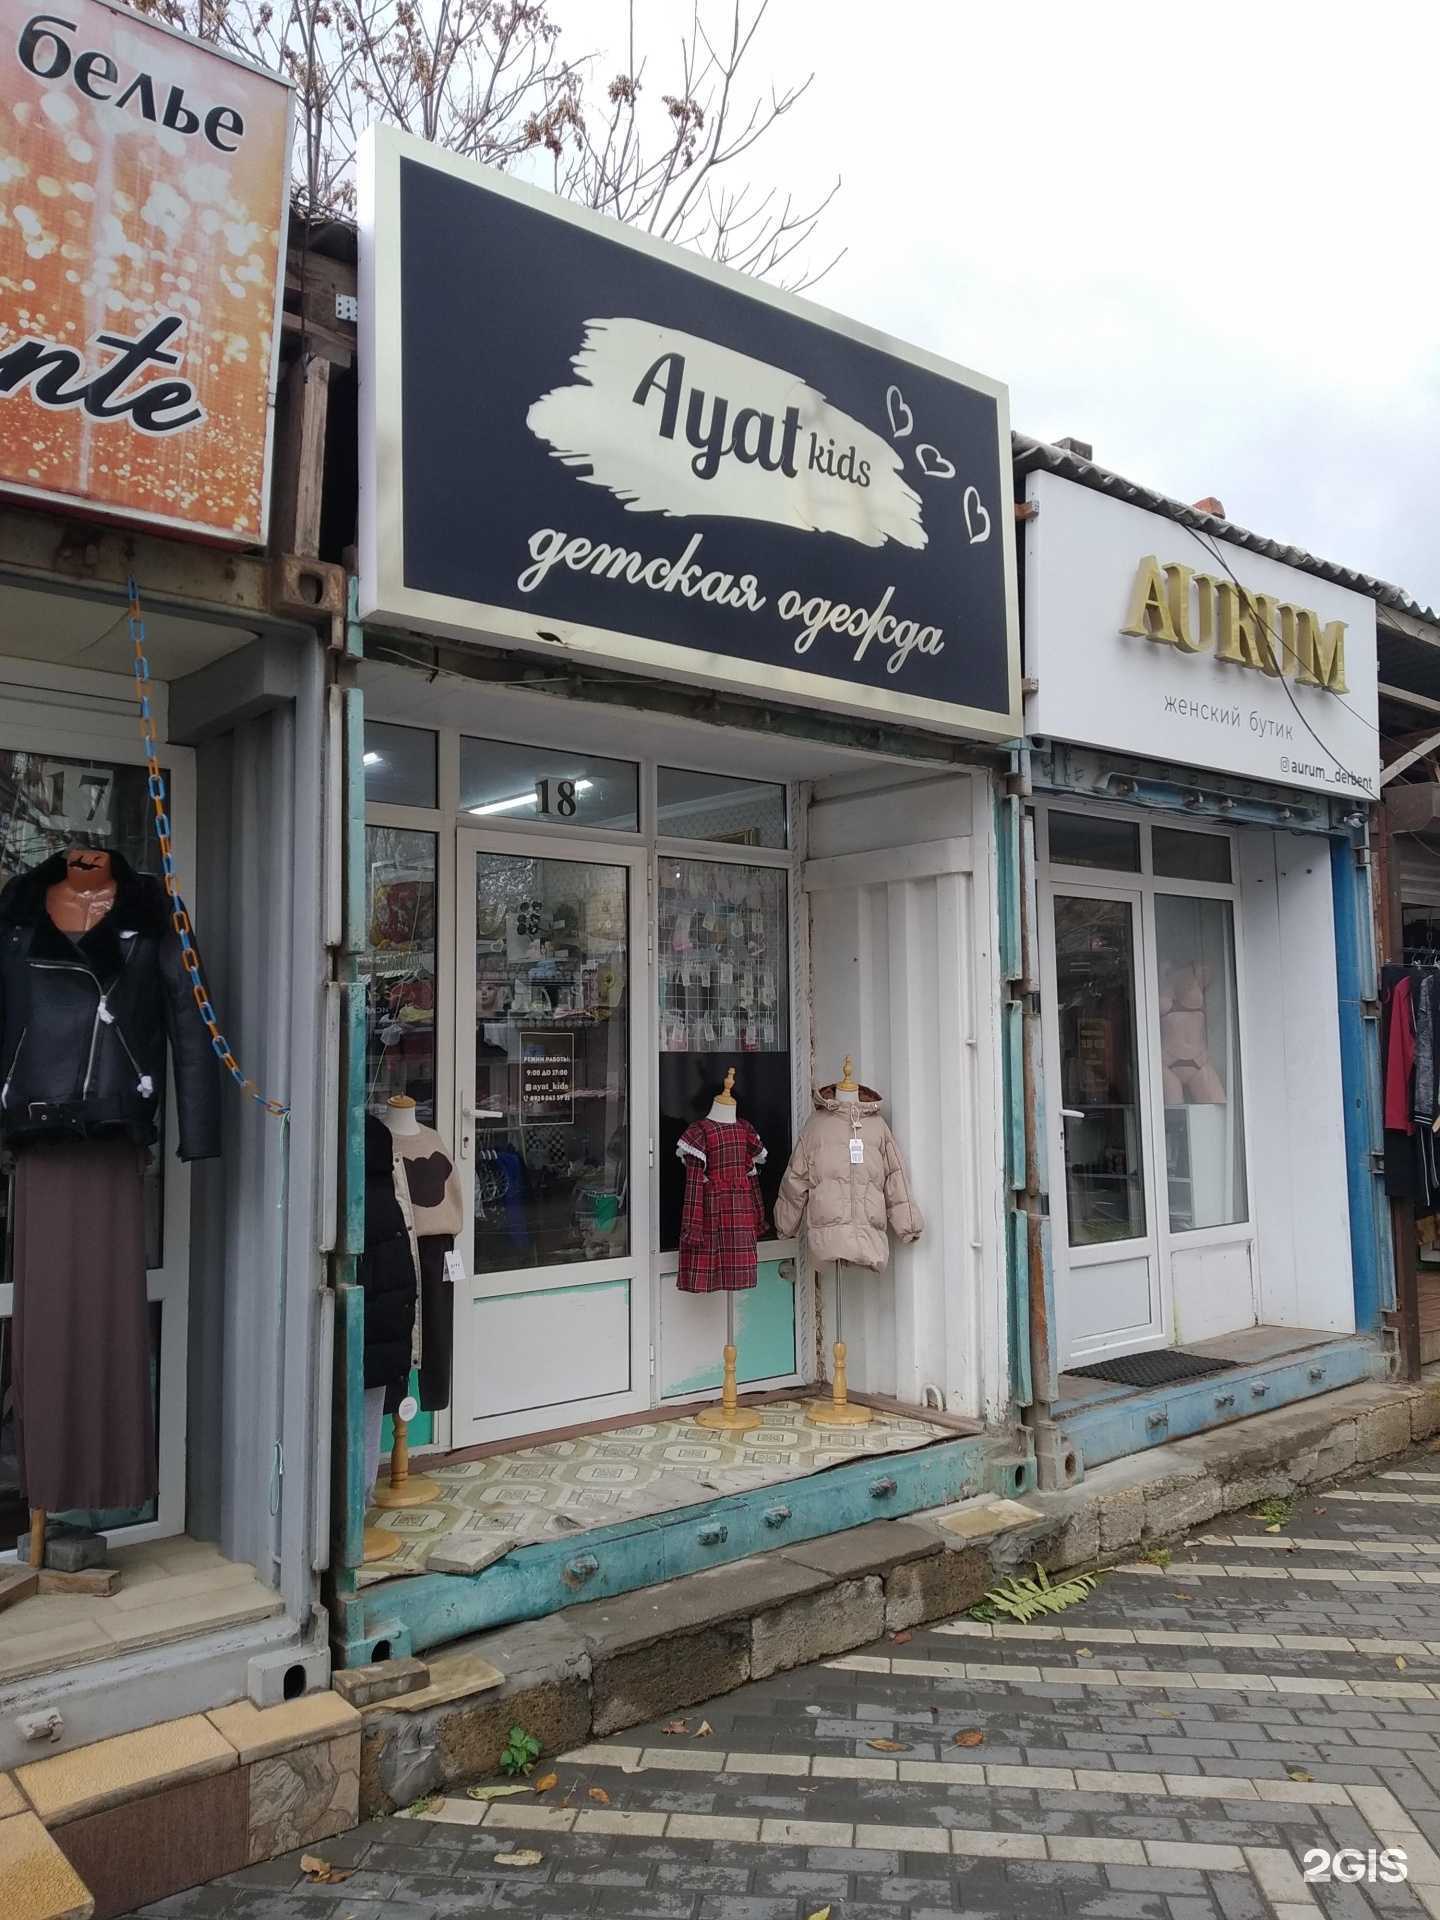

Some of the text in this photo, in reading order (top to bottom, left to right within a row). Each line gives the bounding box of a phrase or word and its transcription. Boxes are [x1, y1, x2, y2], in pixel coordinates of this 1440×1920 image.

[17, 15, 245, 153] белье
[631, 352, 871, 487] Ayat kids
[517, 527, 945, 674] детская одежда
[1119, 553, 1351, 695] AURUM
[1164, 694, 1294, 740] женский бутик
[47, 769, 111, 822] 17
[536, 777, 577, 818] 18
